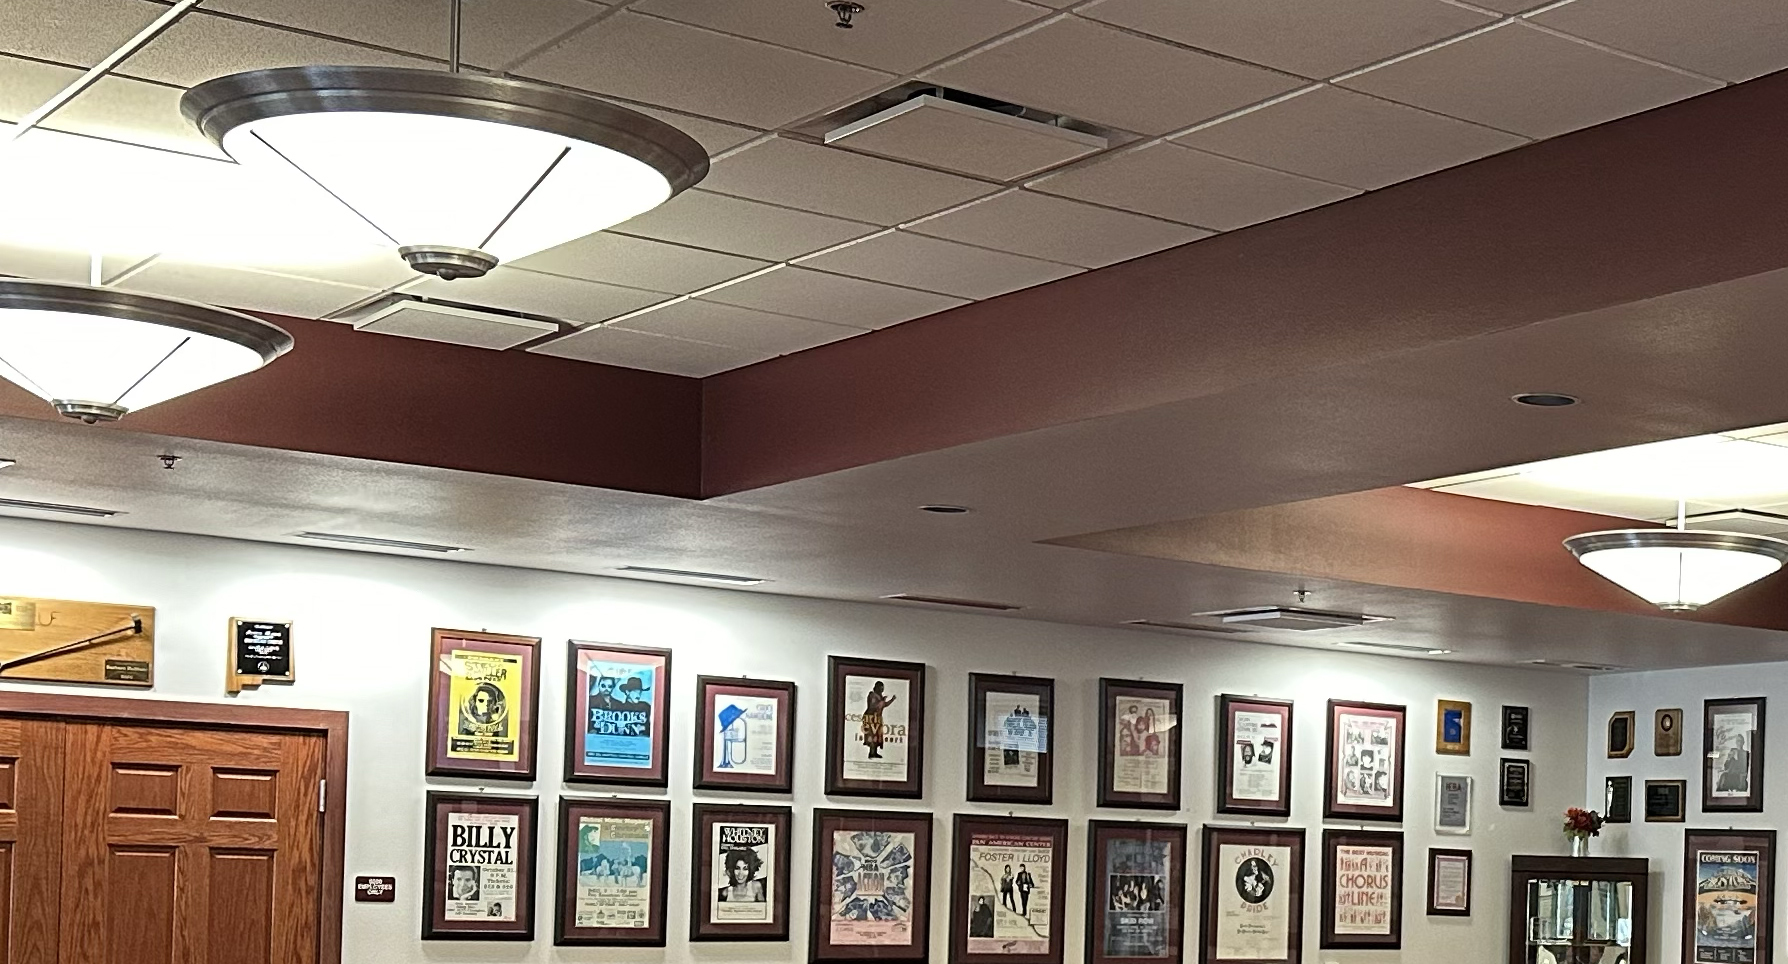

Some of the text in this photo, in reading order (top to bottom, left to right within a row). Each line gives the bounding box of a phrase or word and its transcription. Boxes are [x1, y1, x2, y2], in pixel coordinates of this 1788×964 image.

[591, 708, 647, 724] BROOKS
[599, 722, 641, 736] DUNN
[861, 723, 906, 736] evora
[451, 825, 515, 849] BILLY
[723, 834, 765, 843] HOUSTON
[724, 828, 765, 837] WHITNEY
[450, 849, 513, 865] CRYSTAL
[979, 852, 1050, 863] FOSTER LLOYD
[1235, 848, 1279, 867] CHARLEY
[1701, 855, 1731, 863] COMING
[1340, 874, 1389, 889] CHORUS
[1351, 891, 1376, 906] LINE
[1240, 901, 1268, 914] PRIDE
